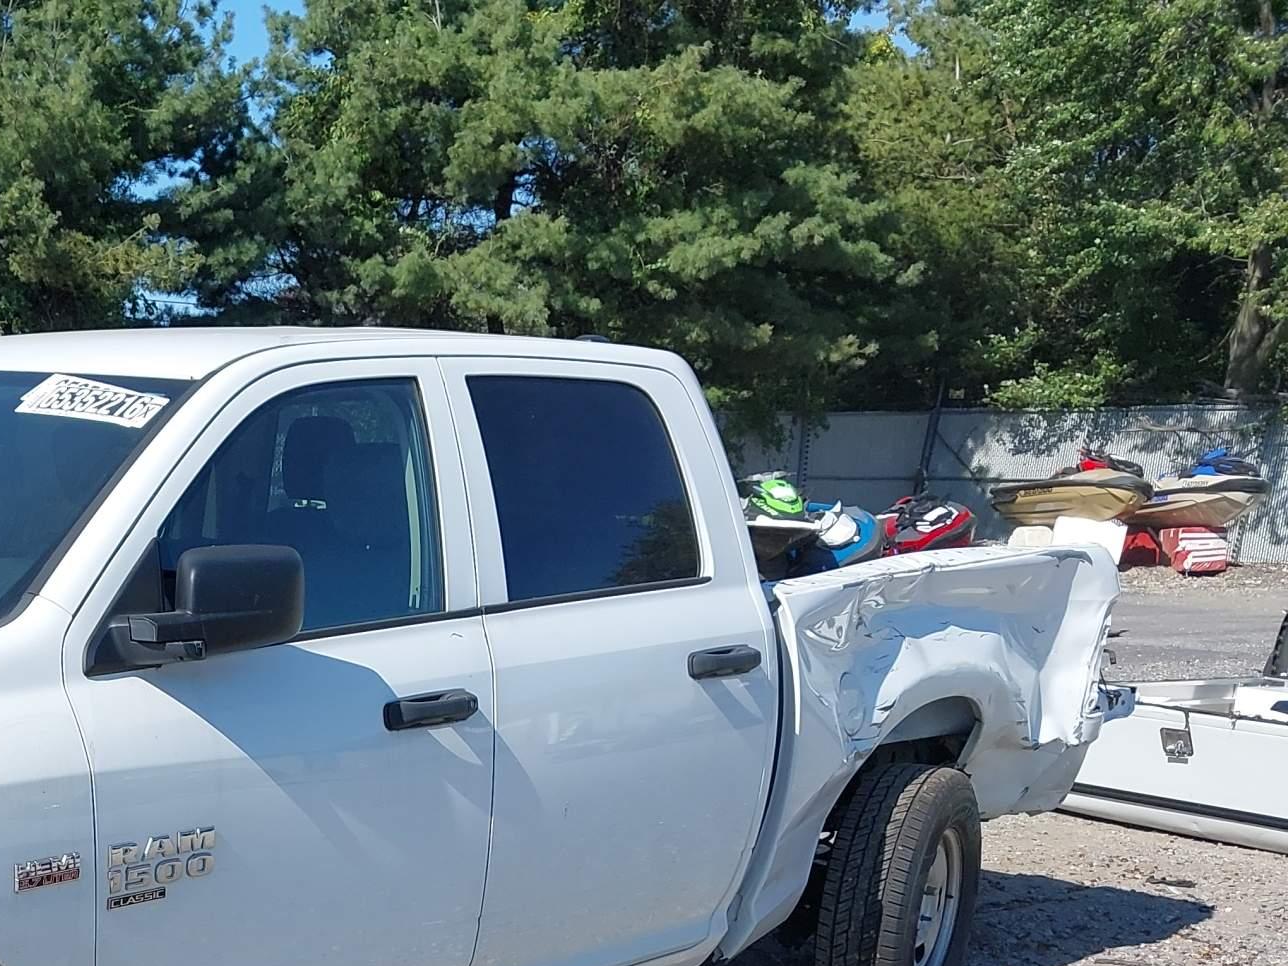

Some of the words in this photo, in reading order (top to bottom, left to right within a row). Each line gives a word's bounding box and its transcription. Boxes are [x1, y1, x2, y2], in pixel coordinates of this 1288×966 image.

[108, 826, 215, 870] RAM
[14, 852, 80, 880] HEMI
[107, 852, 215, 895] 1500
[110, 888, 165, 909] CLASSIC
